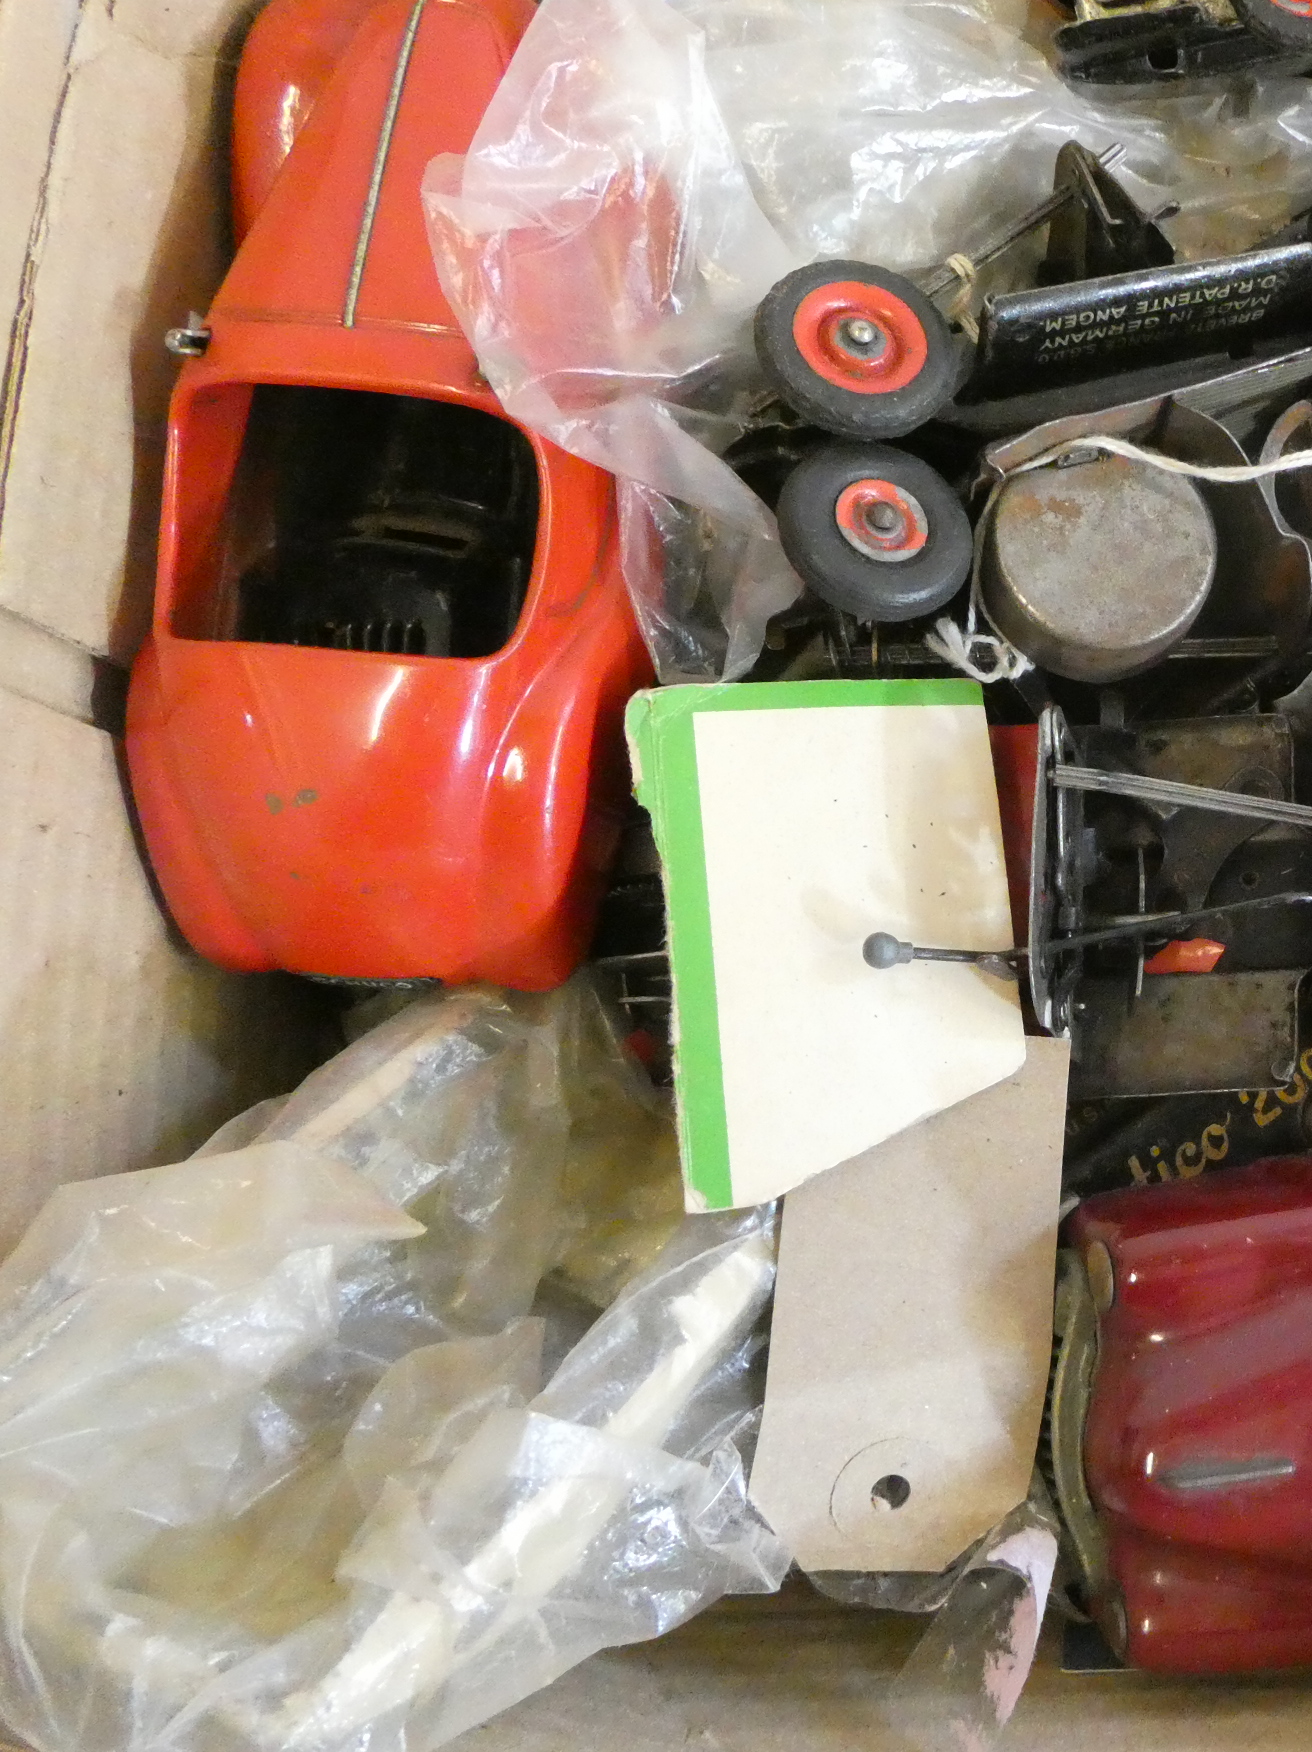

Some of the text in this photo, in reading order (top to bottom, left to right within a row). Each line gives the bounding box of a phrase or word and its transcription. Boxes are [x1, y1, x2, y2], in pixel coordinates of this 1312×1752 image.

[1038, 293, 1271, 351] MADE IN GERMANY
[1040, 303, 1126, 334] ANGEM.
